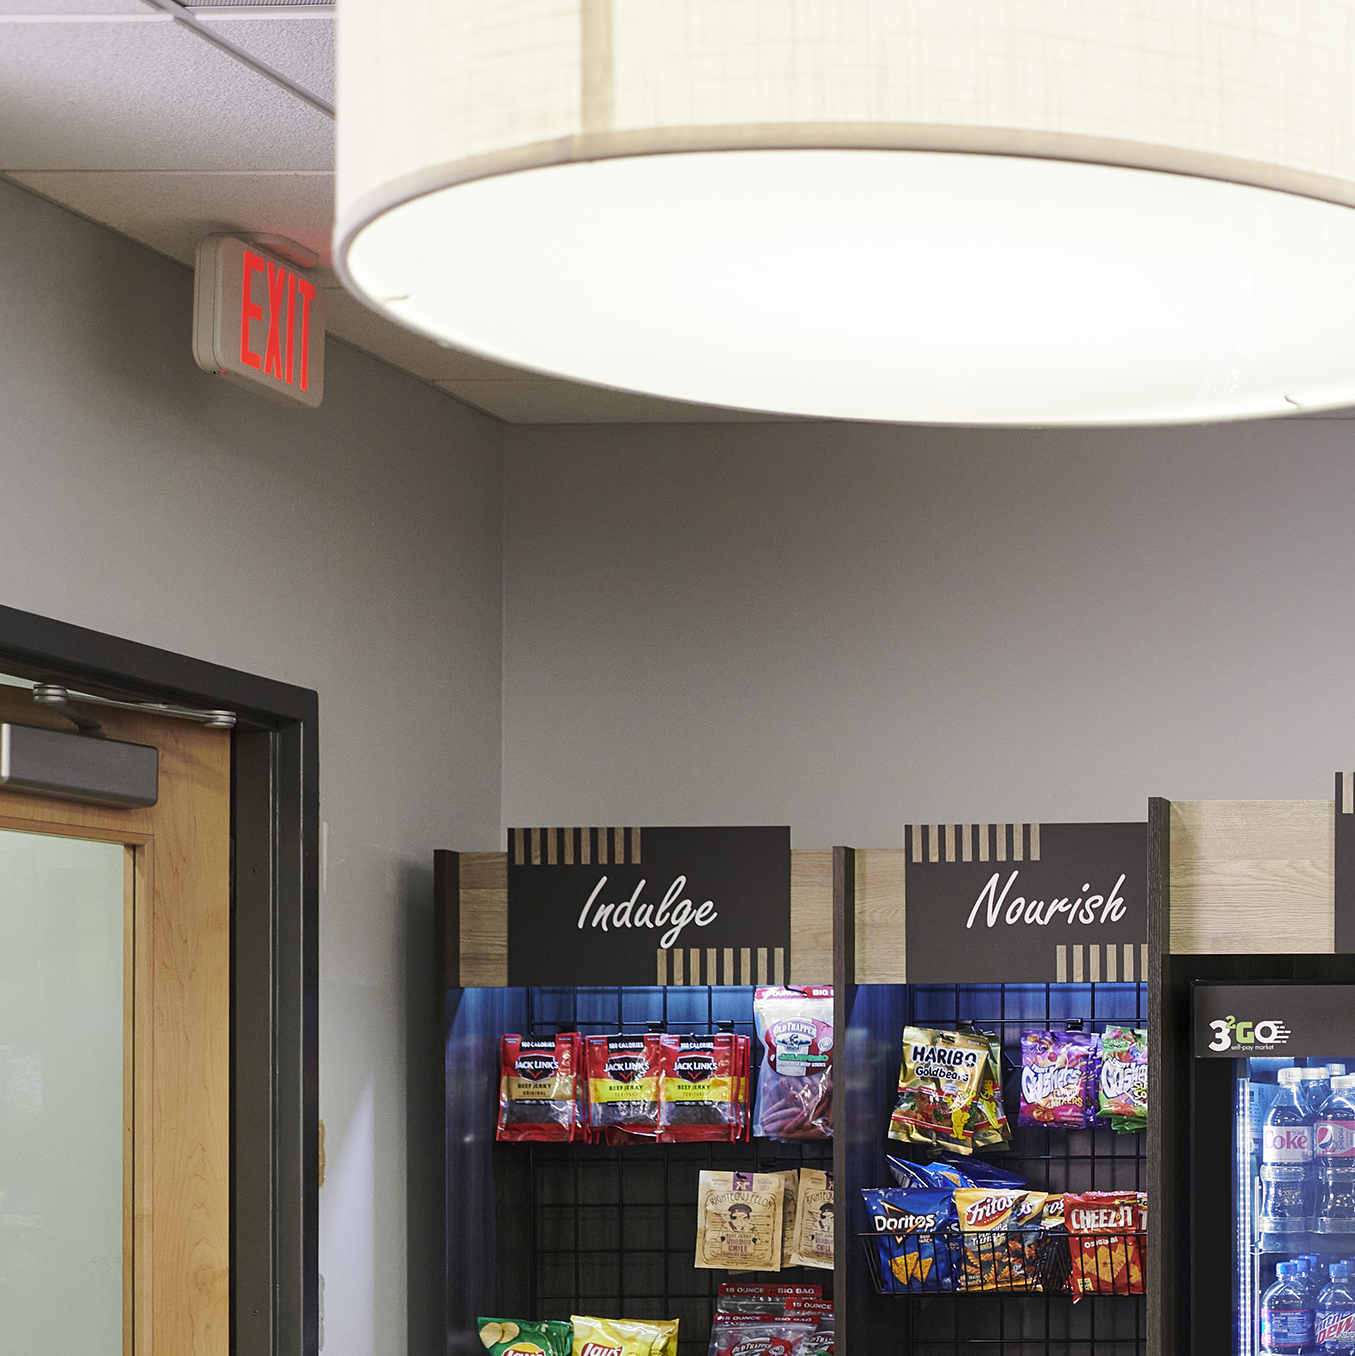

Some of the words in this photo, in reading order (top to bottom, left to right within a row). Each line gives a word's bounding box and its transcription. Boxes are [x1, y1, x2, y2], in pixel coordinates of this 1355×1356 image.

[240, 250, 315, 392] EXIT
[966, 871, 1126, 929] Nourish
[578, 874, 717, 949] Indulge
[912, 1045, 977, 1067] HARIBO
[1231, 1043, 1253, 1052] self-pay
[514, 1060, 535, 1070] JACK
[535, 1060, 559, 1069] LINK'S
[673, 1061, 695, 1071] JACK
[694, 1061, 718, 1070] LINK'S
[1265, 1131, 1308, 1150] Coke
[966, 1195, 1014, 1224] Fritos
[874, 1214, 935, 1232] Doritos
